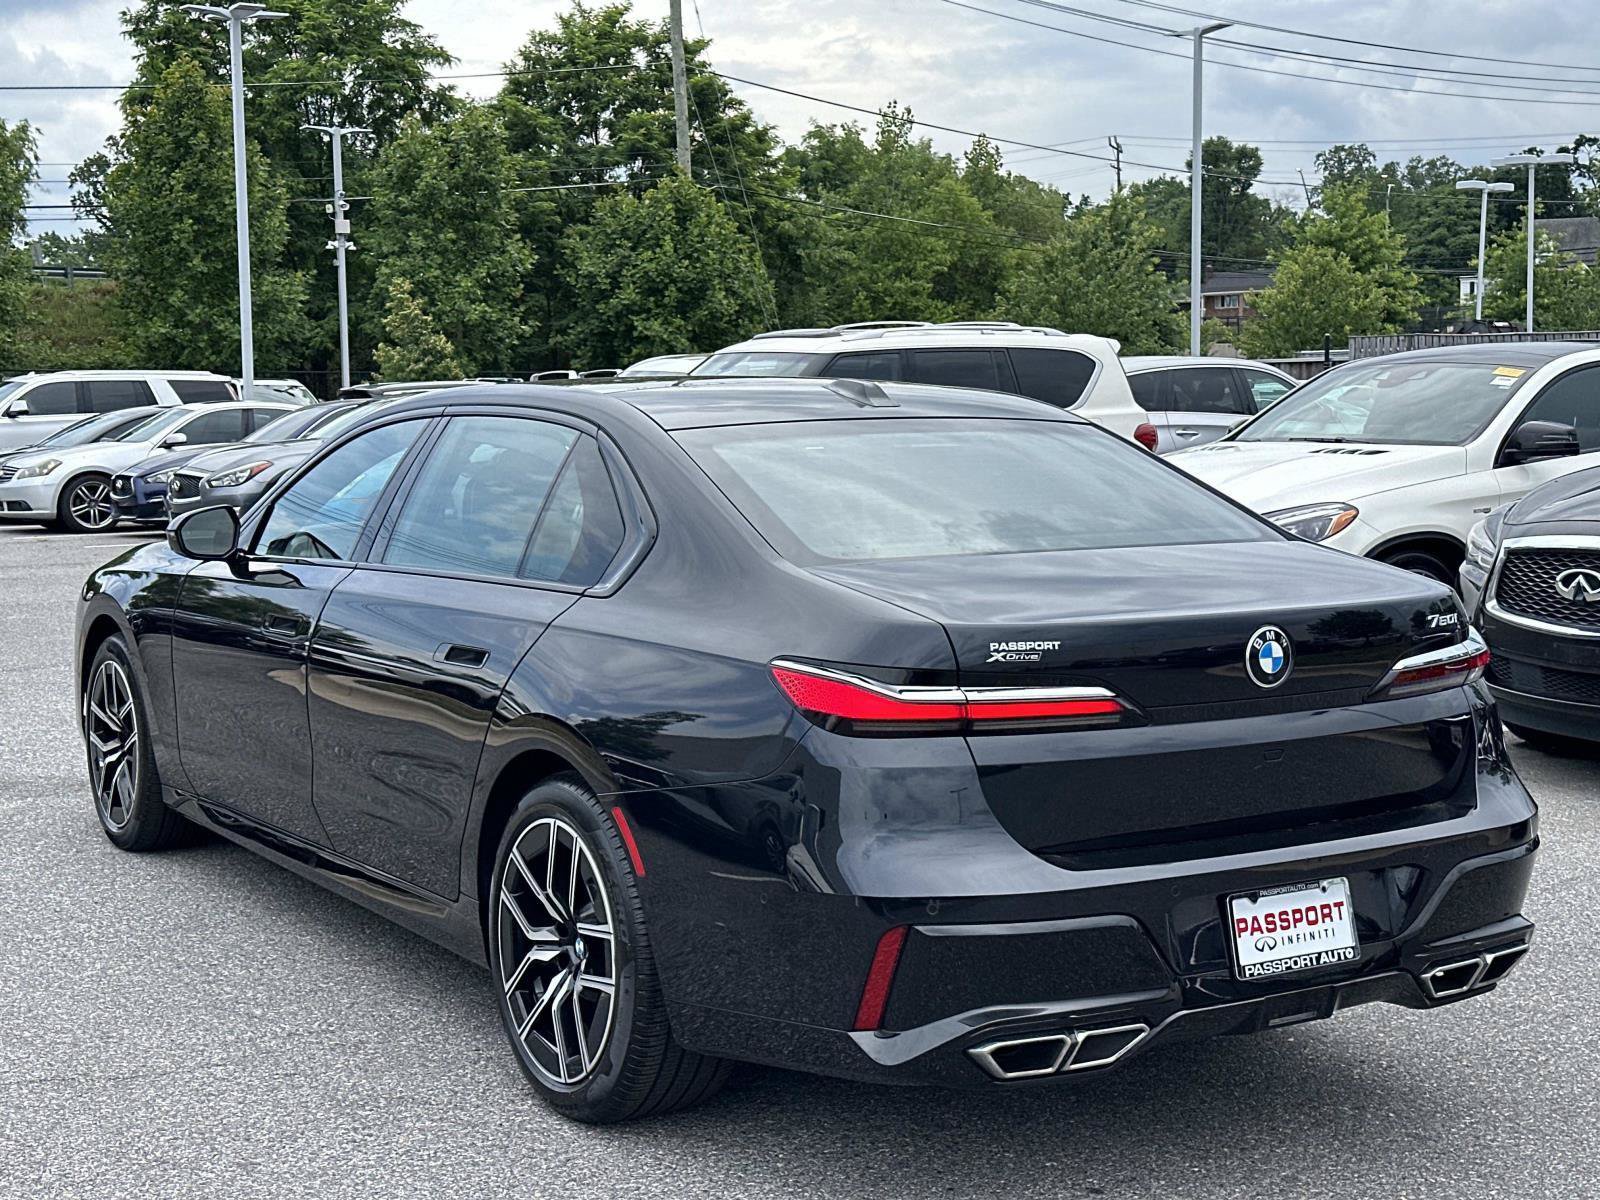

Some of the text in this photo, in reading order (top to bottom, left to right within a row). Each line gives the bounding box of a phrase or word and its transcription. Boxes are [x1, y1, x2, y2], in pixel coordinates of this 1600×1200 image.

[989, 641, 1061, 651] PASSPORT
[1253, 630, 1288, 650] BMW
[1235, 901, 1344, 938] PASSPORT
[1281, 928, 1335, 946] INFINITI
[1245, 948, 1354, 978] PASSPORT AUTO
